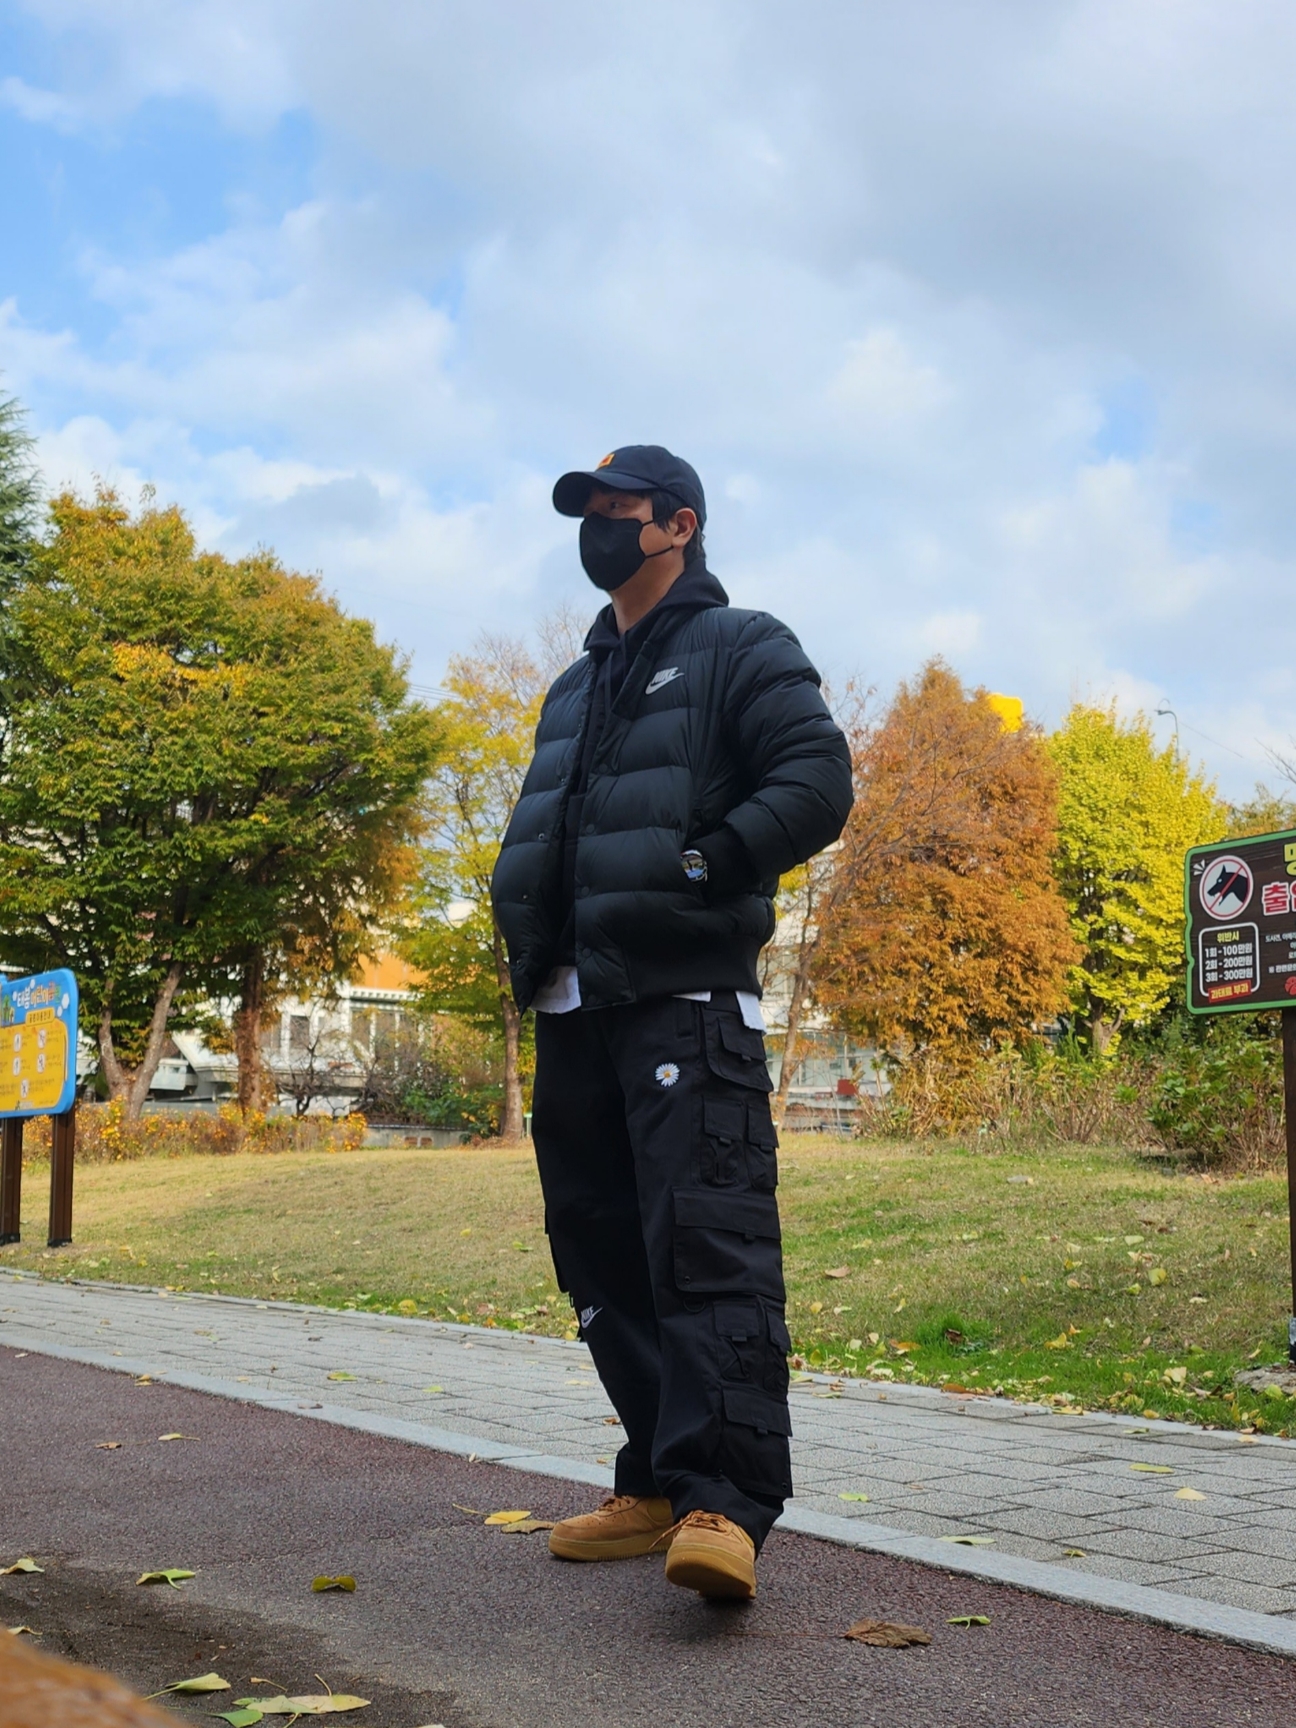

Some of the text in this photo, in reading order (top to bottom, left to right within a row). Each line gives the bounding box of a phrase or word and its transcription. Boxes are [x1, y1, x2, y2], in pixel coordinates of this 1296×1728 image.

[1217, 930, 1239, 943] 위반시
[1205, 947, 1217, 958] 1회
[1222, 942, 1252, 956] 100만원
[1205, 959, 1218, 970] 2회
[1223, 955, 1253, 968] 200만원
[1205, 971, 1218, 982] 3회
[1223, 967, 1253, 980] 300만원
[1210, 983, 1249, 999] 과태료 부과
